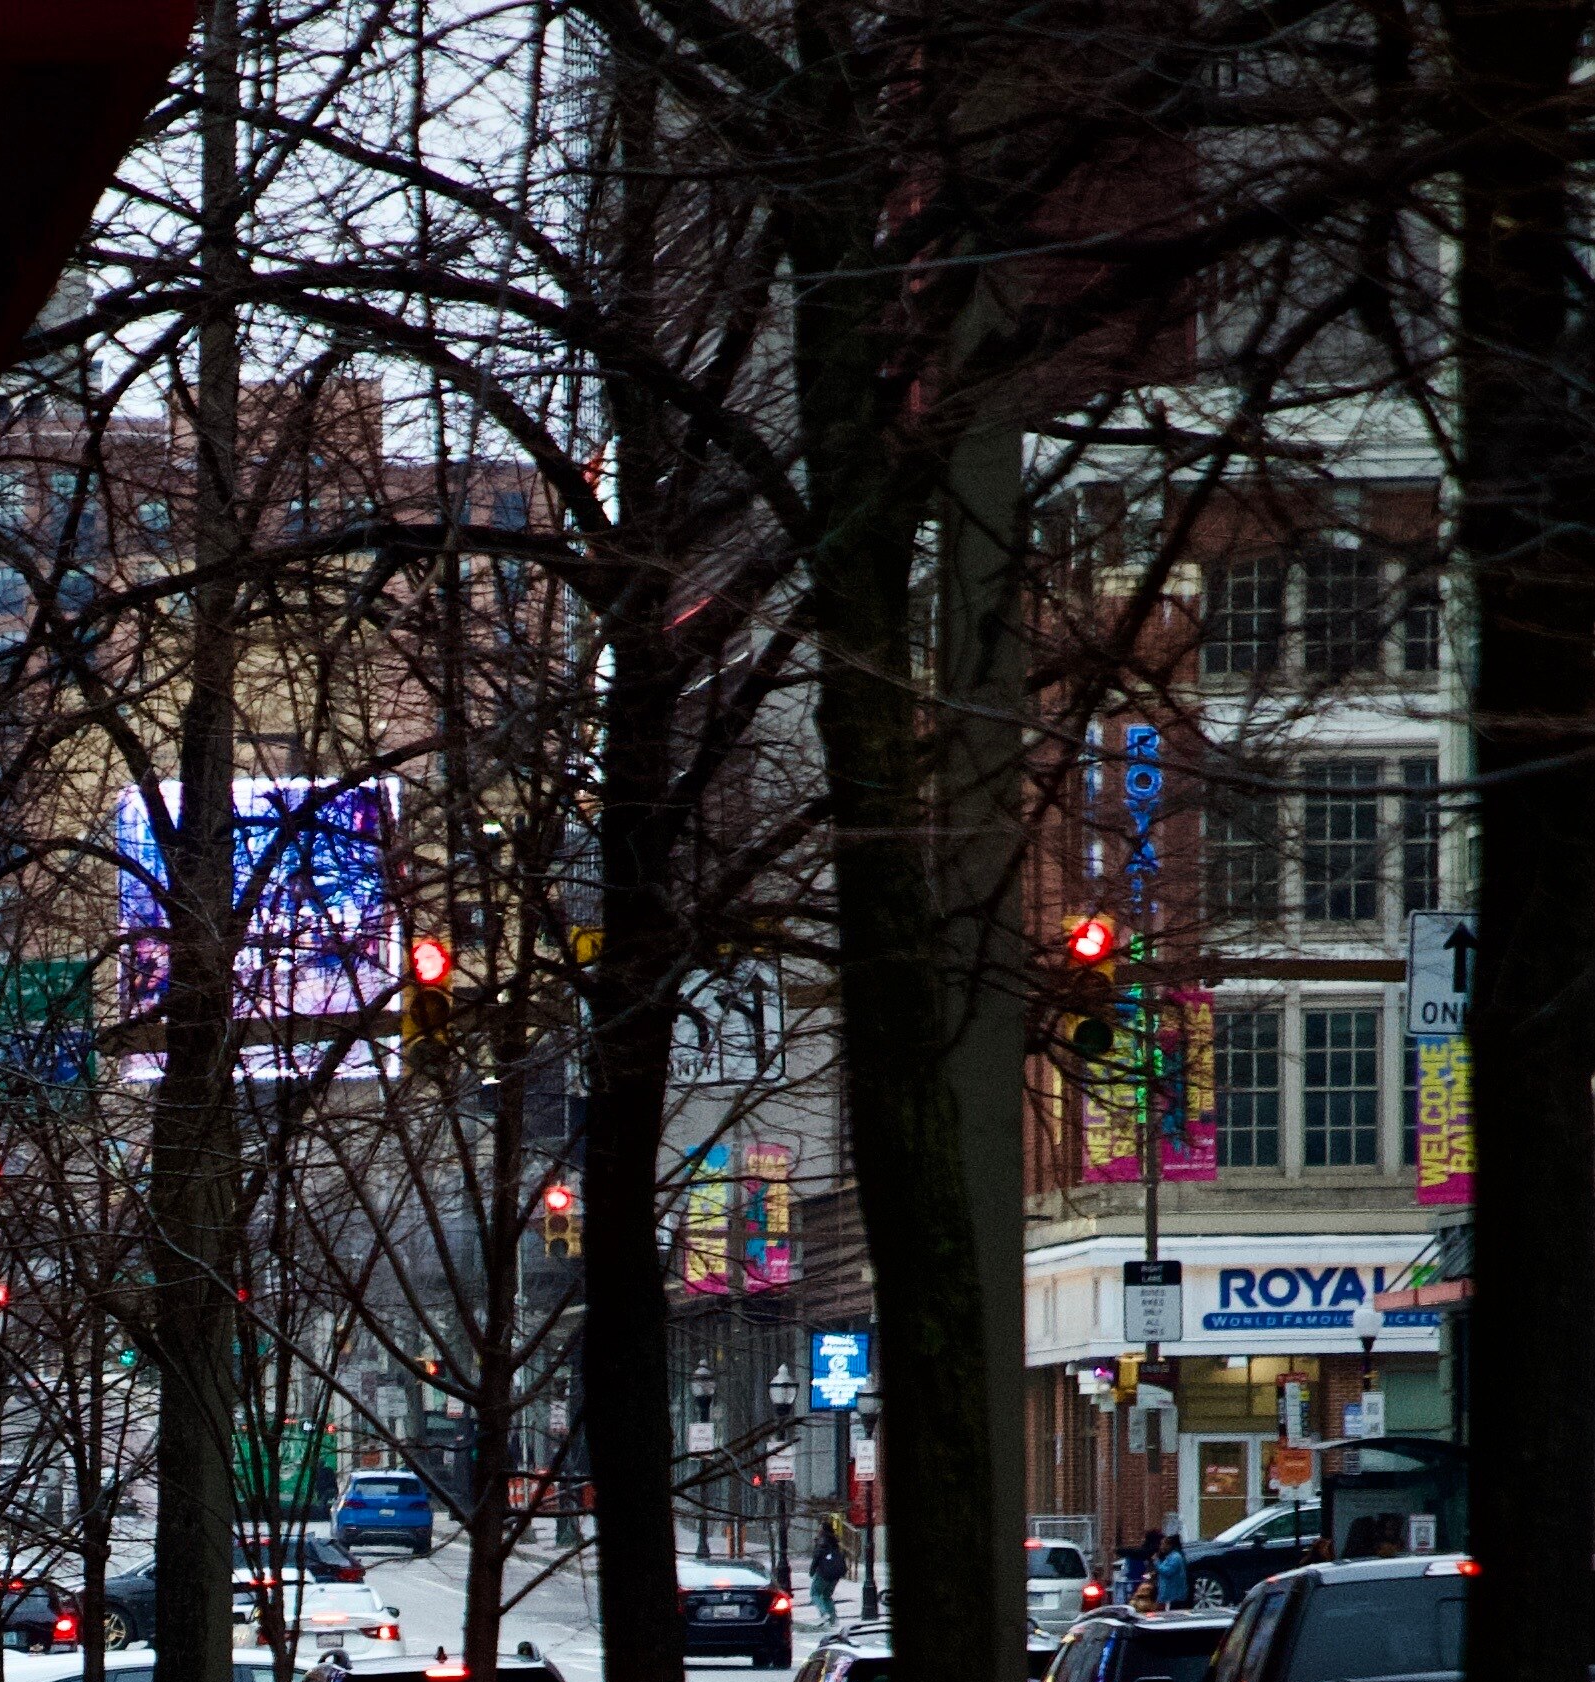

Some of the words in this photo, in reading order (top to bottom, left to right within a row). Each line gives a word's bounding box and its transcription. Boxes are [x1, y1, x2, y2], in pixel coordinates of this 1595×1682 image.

[1421, 1002, 1466, 1025] ON
[1419, 1044, 1449, 1187] WELCOME
[1450, 1038, 1477, 1173] BALTIMO
[1211, 1315, 1277, 1329] WORLD
[1382, 1311, 1442, 1326] ICKEN
